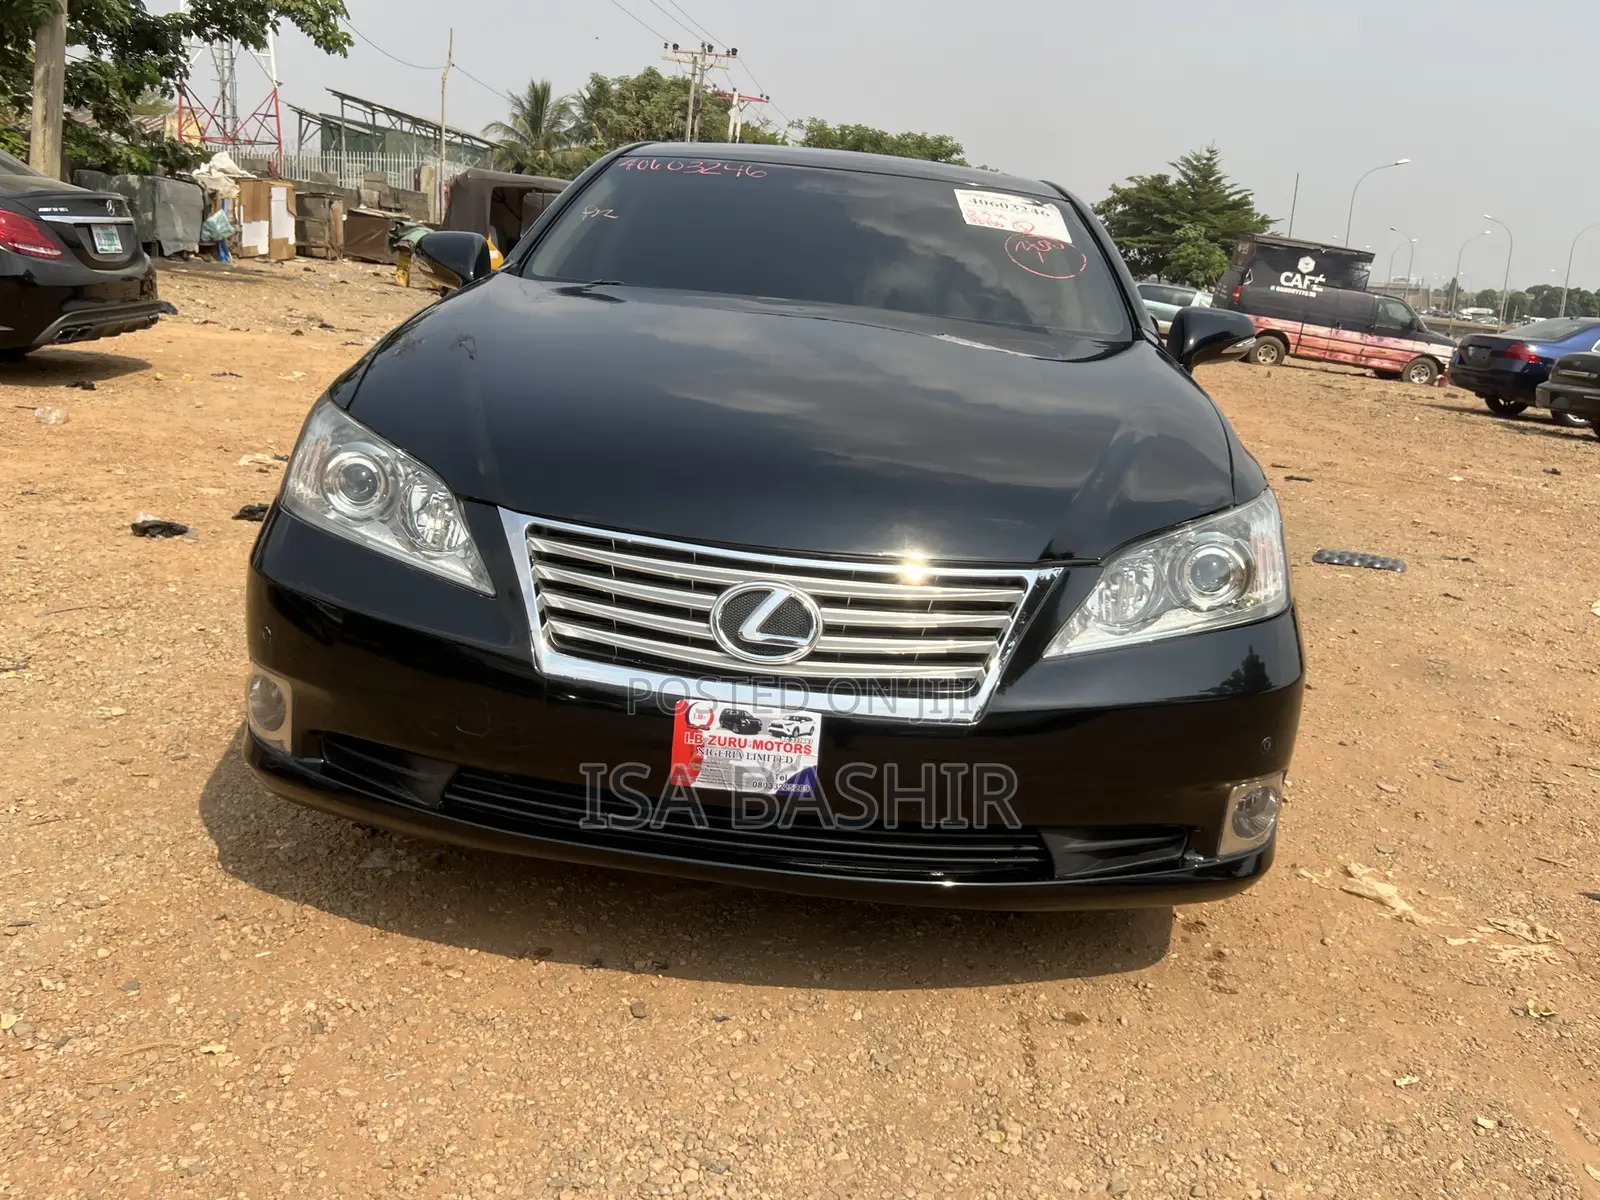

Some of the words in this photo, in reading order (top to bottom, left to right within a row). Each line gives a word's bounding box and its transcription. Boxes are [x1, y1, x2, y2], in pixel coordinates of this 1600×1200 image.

[619, 158, 767, 178] 40603246
[969, 198, 1050, 217] 40603246
[708, 734, 748, 749] ZURU
[752, 738, 812, 755] MOTORS
[697, 747, 743, 760] NIGERIA
[746, 752, 794, 764] LIMITED
[775, 773, 788, 781] Tel
